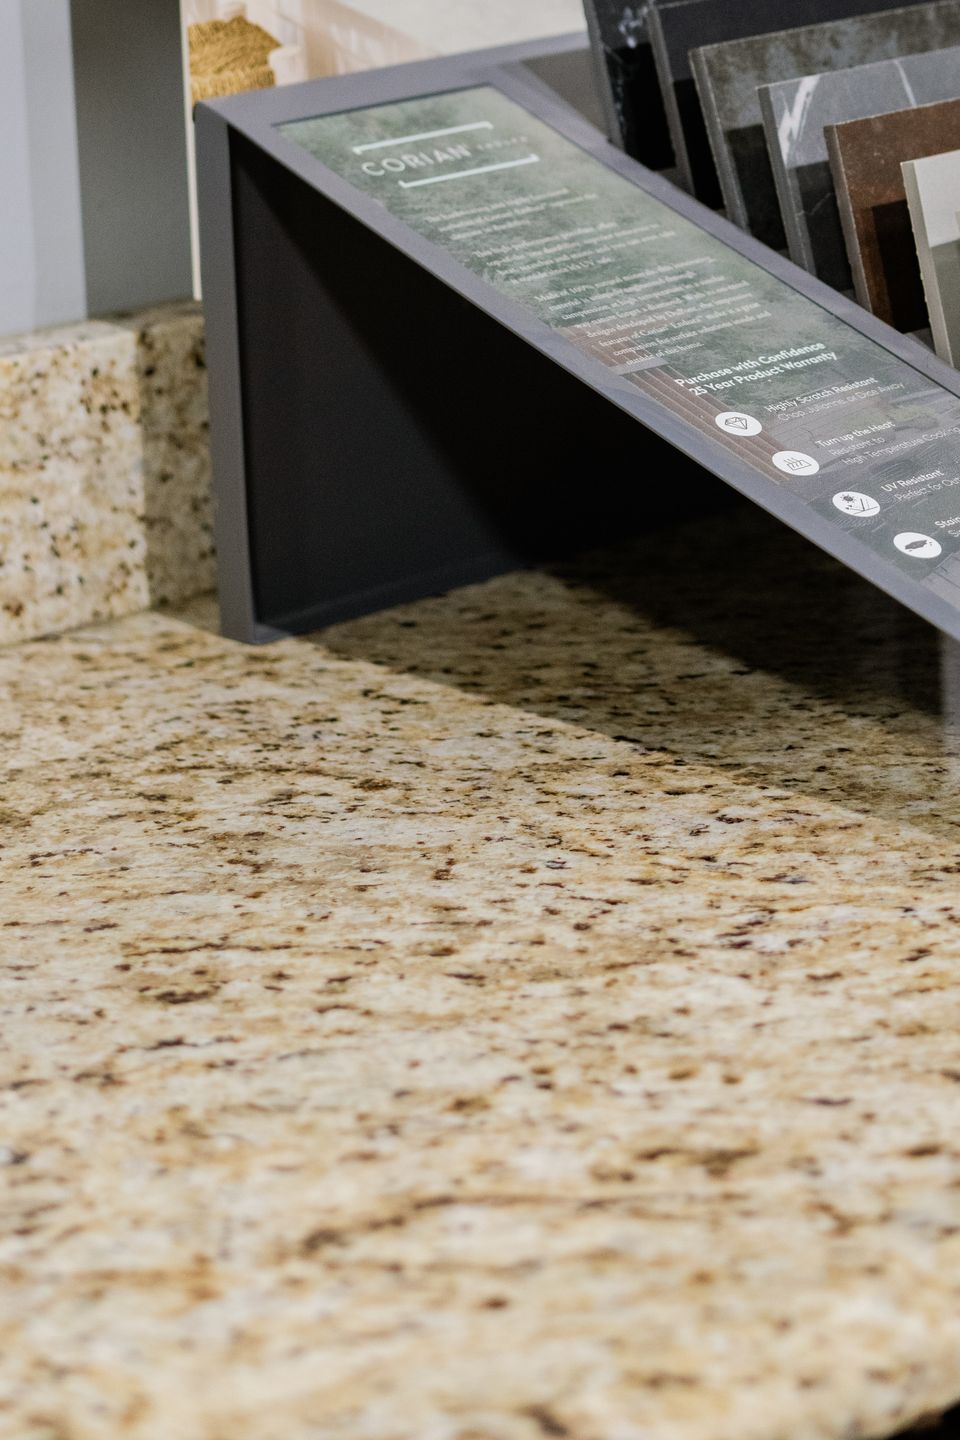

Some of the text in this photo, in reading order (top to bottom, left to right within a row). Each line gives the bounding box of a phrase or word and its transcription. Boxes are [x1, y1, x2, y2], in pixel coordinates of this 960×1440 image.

[672, 342, 829, 386] Purchase with Confidence
[688, 352, 843, 395] 25 Year Product Warranty
[763, 376, 880, 412] Highly Scratch Resistant
[815, 438, 840, 446] Turn
[850, 428, 873, 437] the
[866, 420, 897, 432] Heat
[840, 453, 869, 465] High
[863, 438, 927, 458] Temperature
[879, 469, 945, 491] UV Resistant
[892, 486, 932, 501] Perfect
